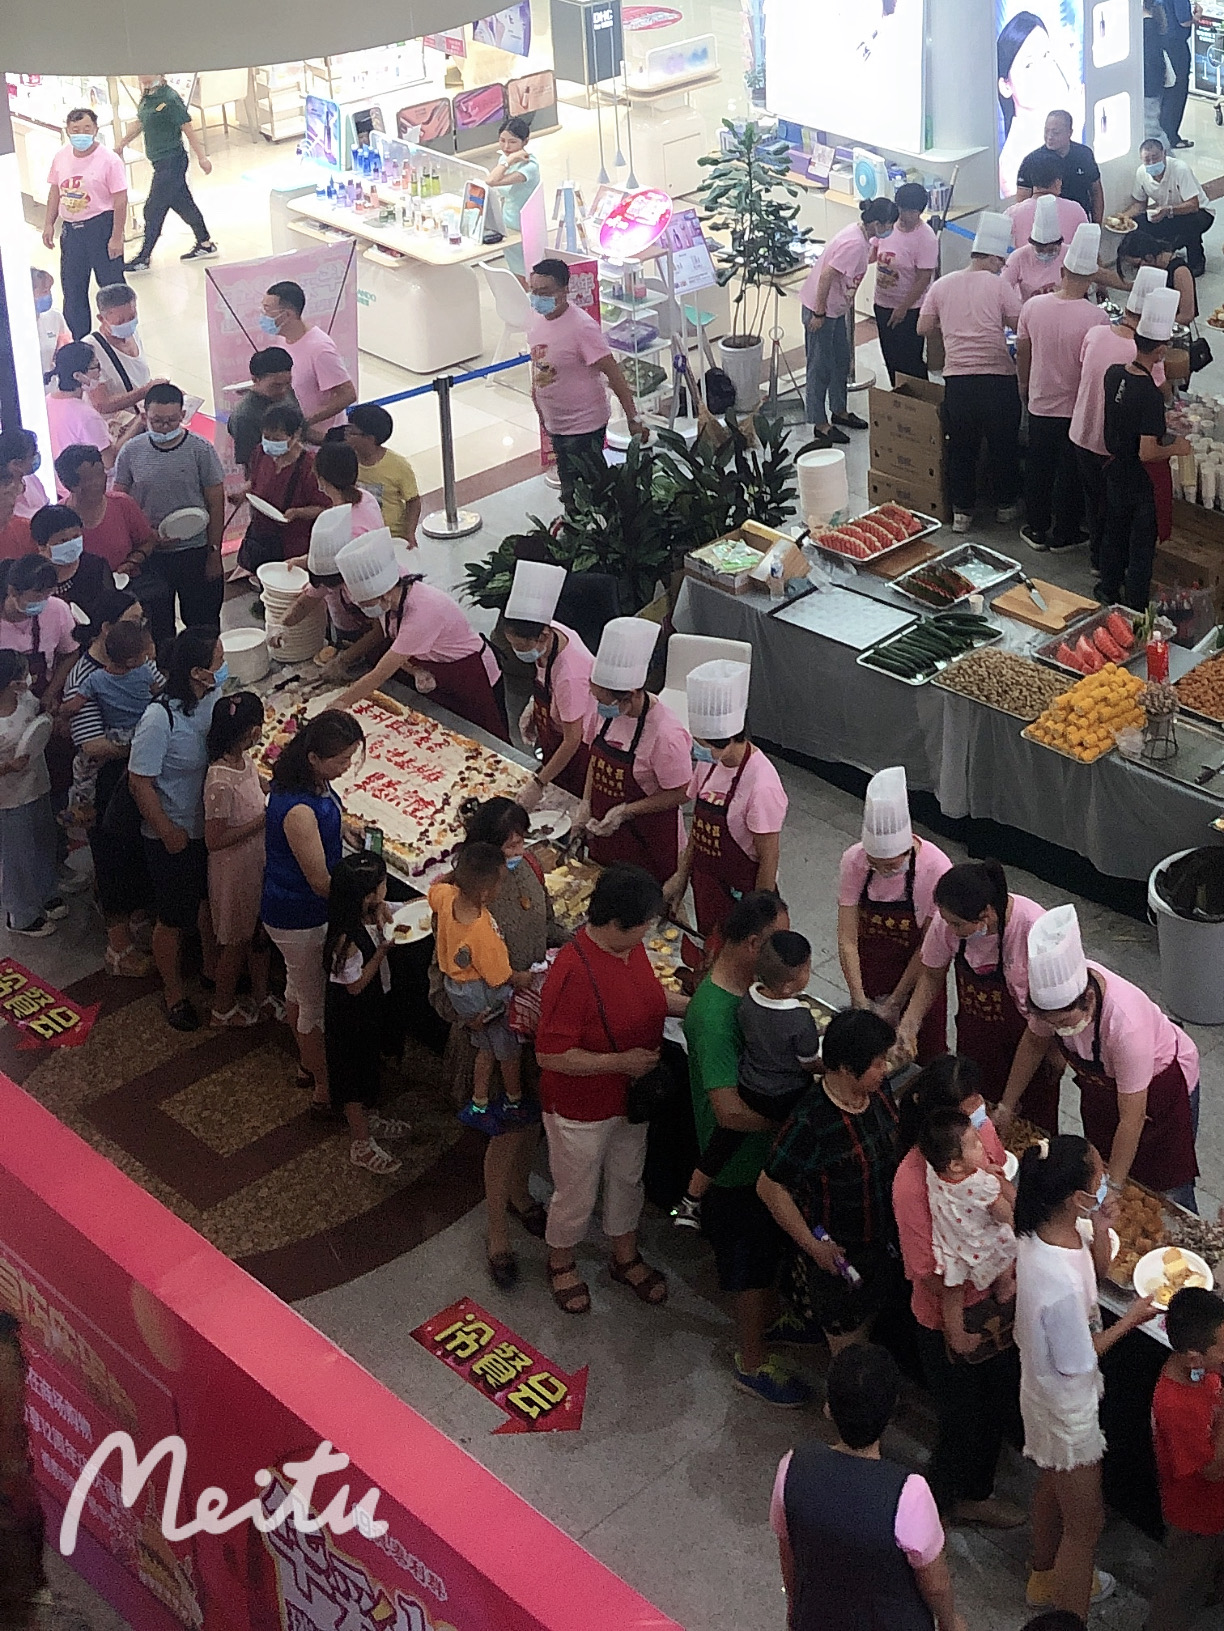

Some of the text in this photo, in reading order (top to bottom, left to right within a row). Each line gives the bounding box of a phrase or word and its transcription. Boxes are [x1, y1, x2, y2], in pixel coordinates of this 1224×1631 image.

[593, 9, 613, 24] DHC
[433, 1313, 568, 1419] 冷餐会
